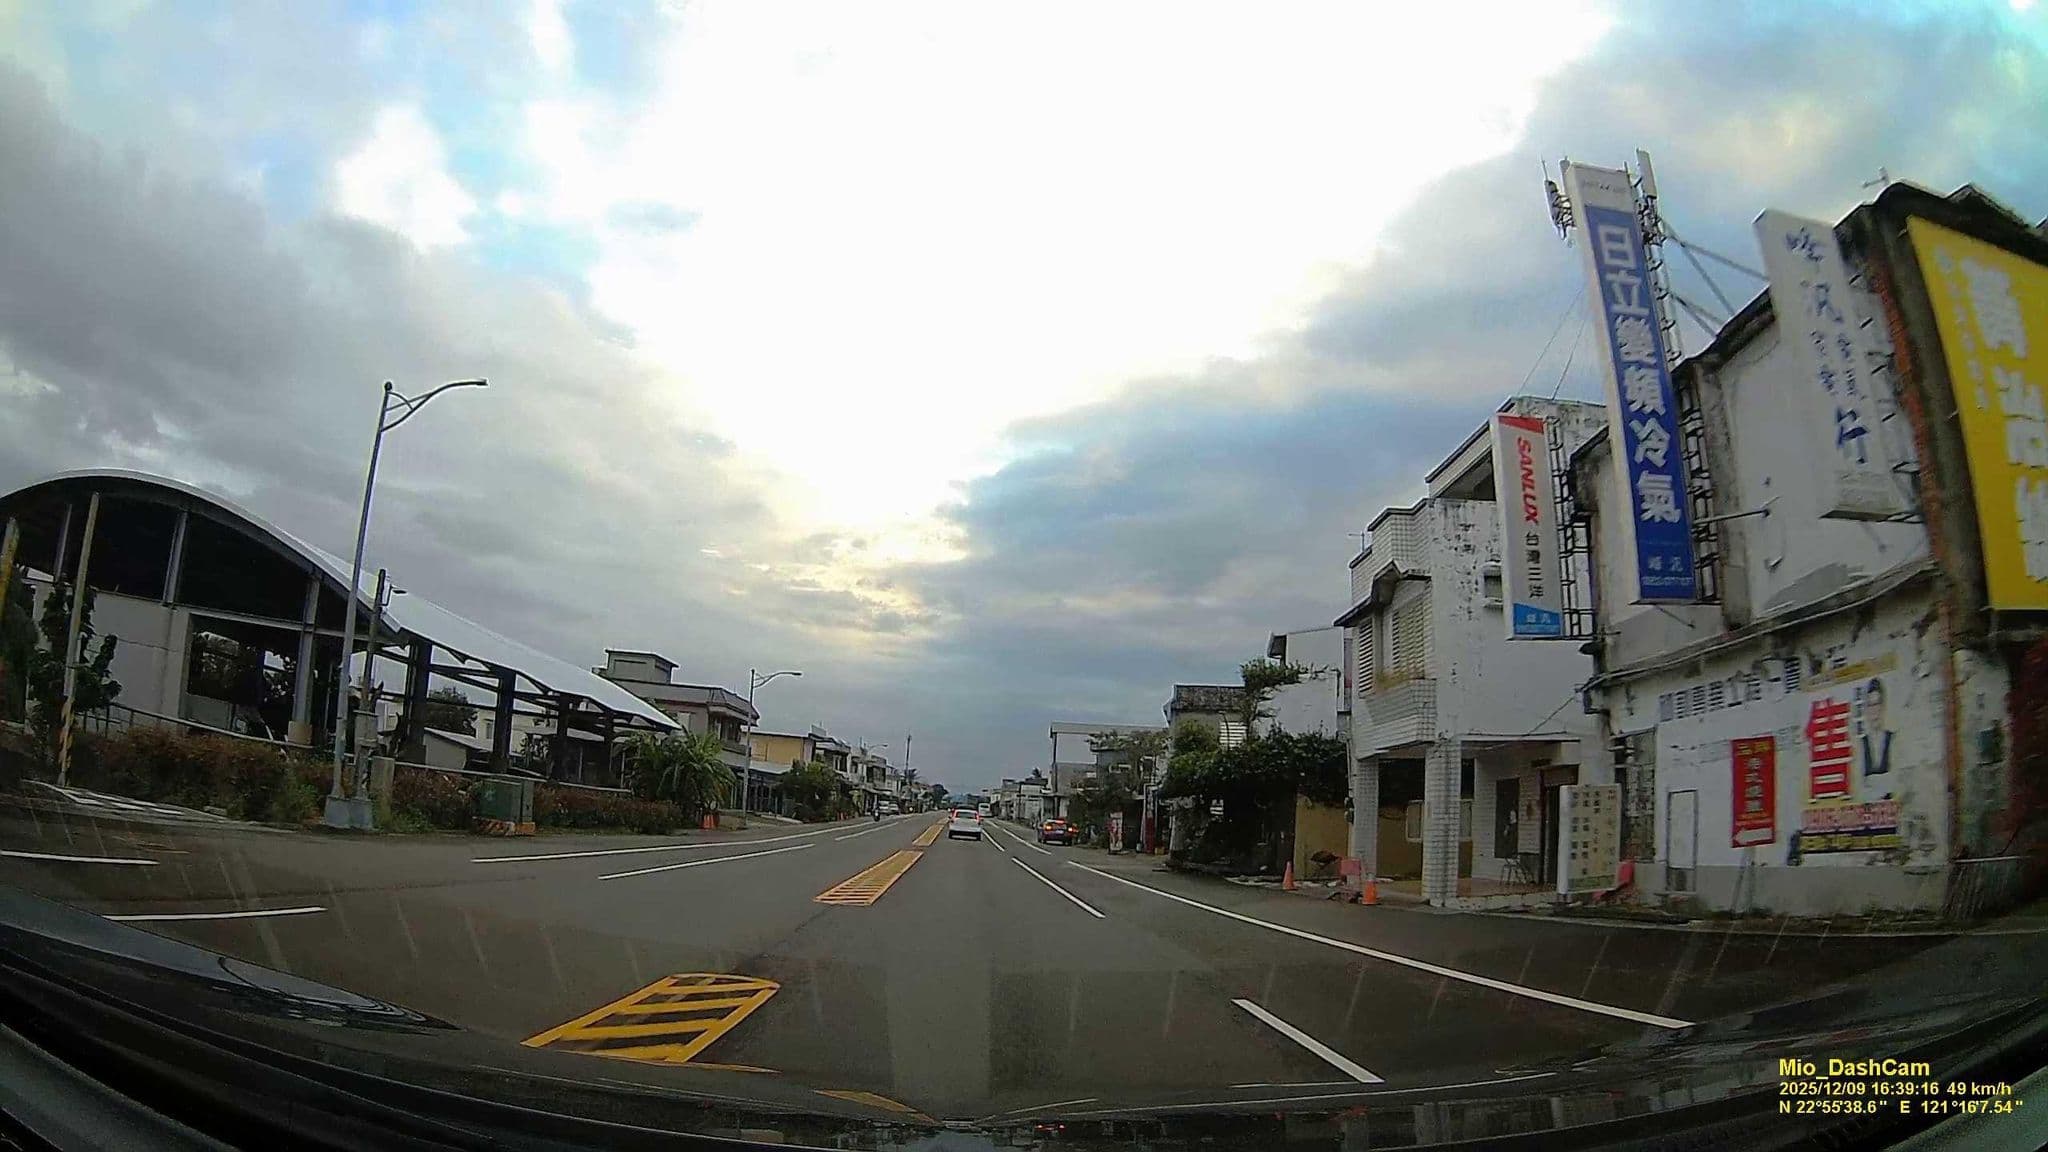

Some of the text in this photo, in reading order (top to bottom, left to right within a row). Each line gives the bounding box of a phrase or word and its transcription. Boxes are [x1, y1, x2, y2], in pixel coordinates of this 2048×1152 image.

[1516, 436, 1540, 526] SANLUX
[1524, 531, 1545, 599] 台灣三洋
